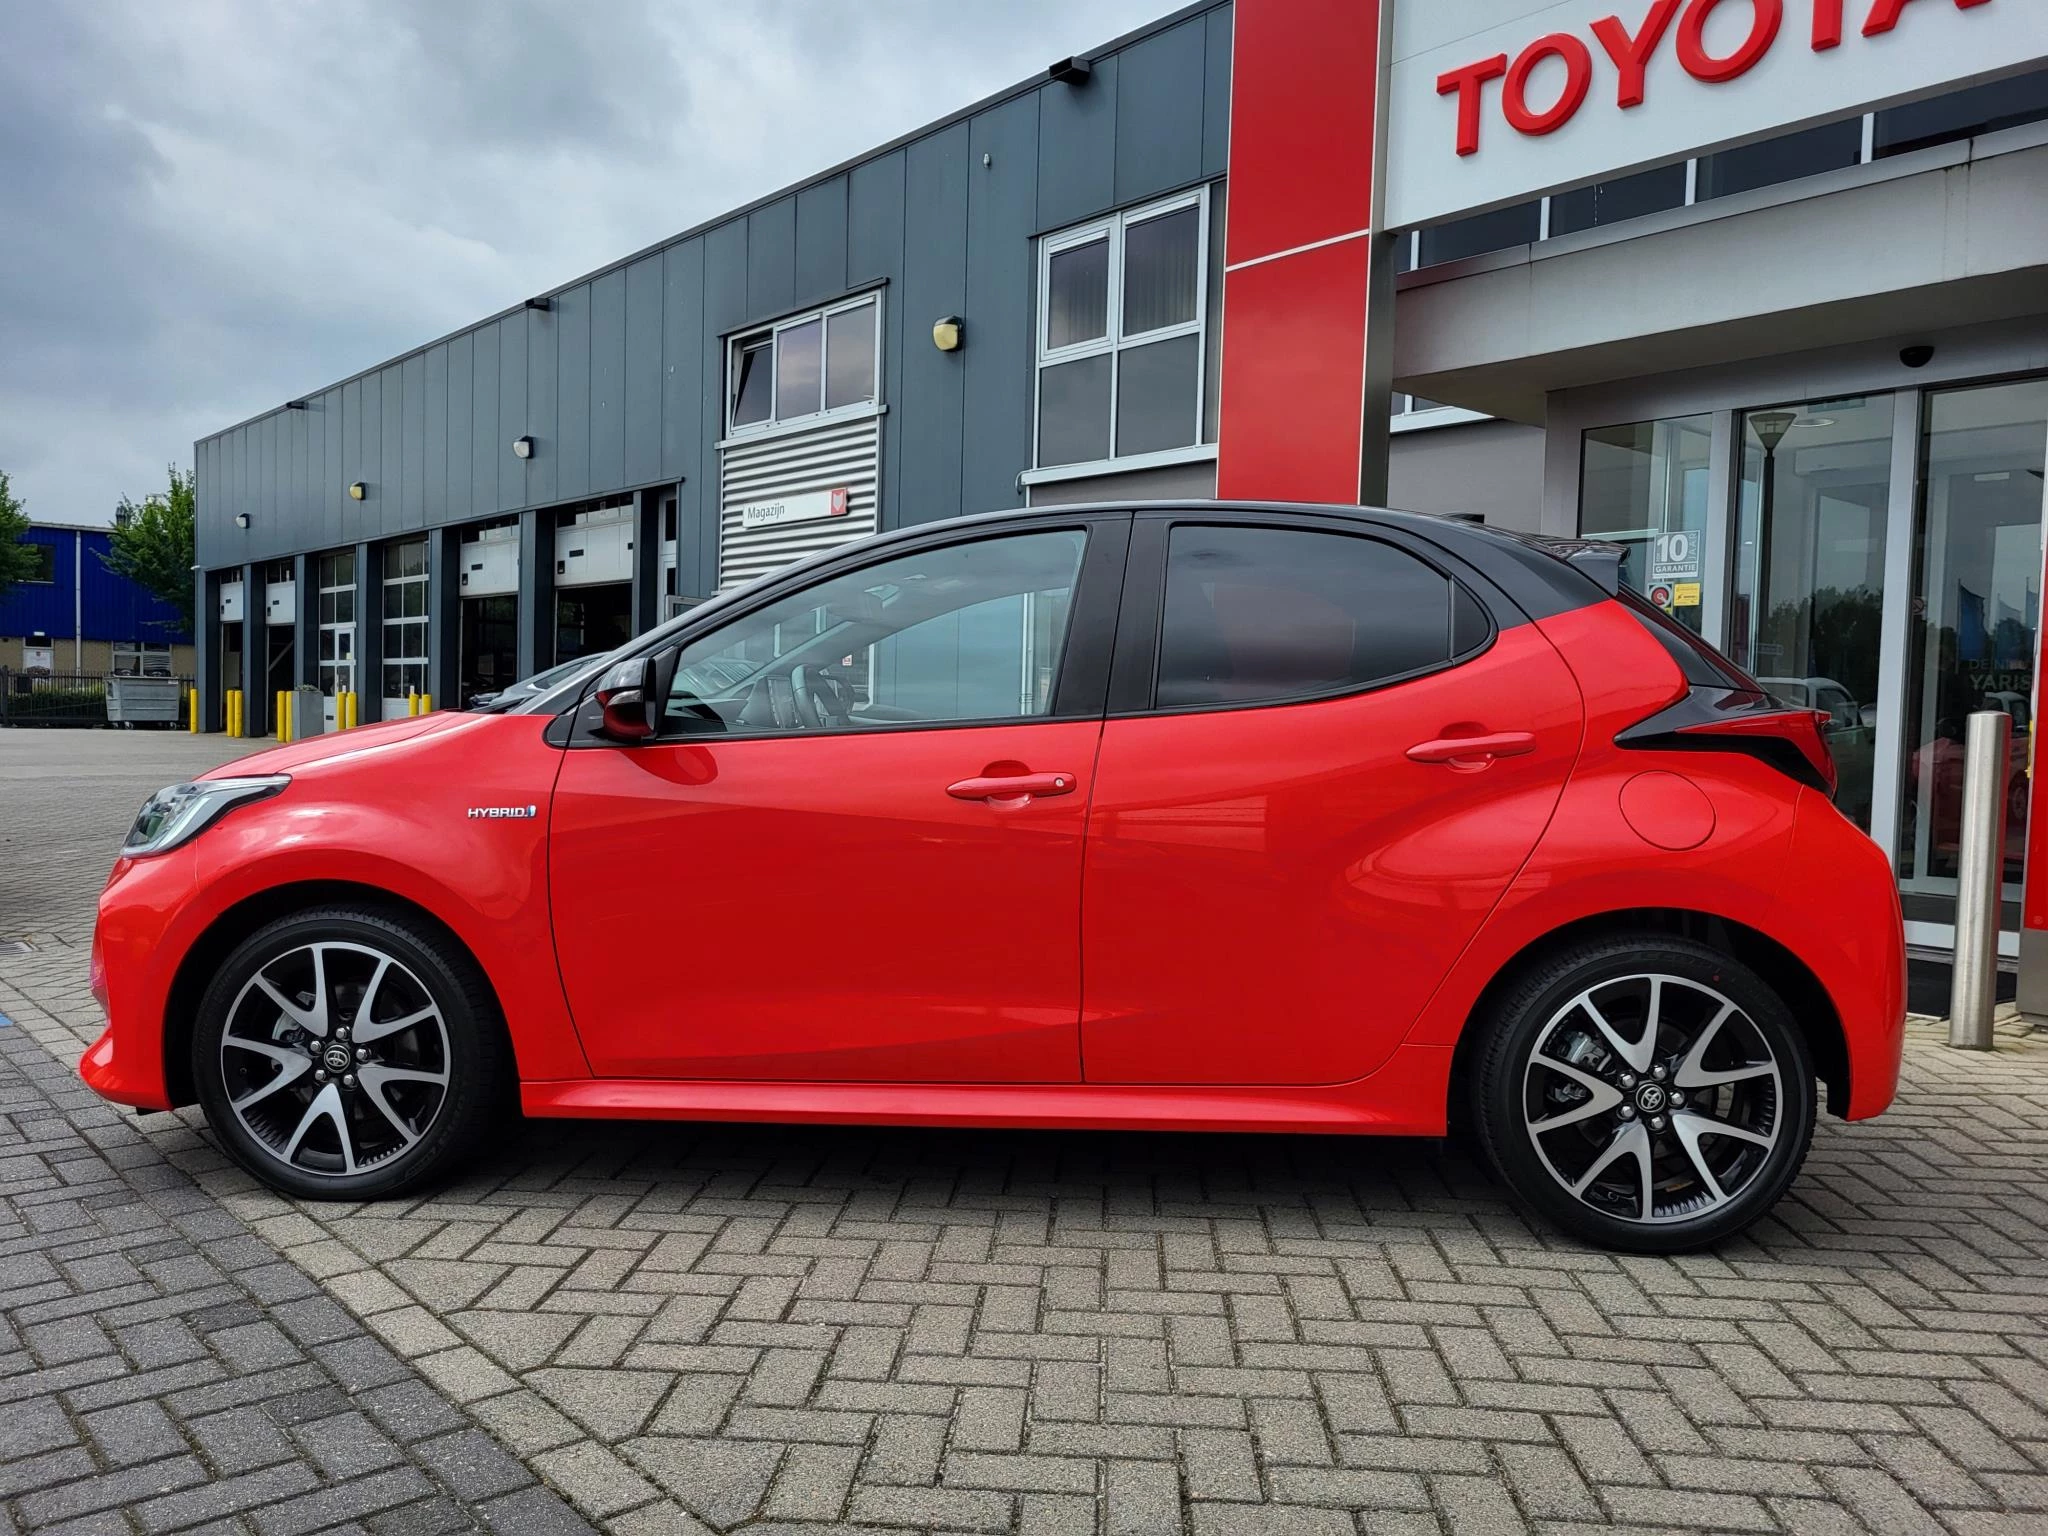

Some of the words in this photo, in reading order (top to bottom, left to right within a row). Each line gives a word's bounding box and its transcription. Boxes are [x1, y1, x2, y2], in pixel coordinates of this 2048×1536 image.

[1437, 0, 1992, 158] TOYO
[747, 503, 785, 522] Magazijn
[1657, 534, 1688, 562] 10
[1688, 533, 1697, 561] JAAR
[1655, 564, 1696, 573] GARANTIE
[1970, 675, 2031, 689] YARIS
[467, 807, 525, 818] HYBRID
